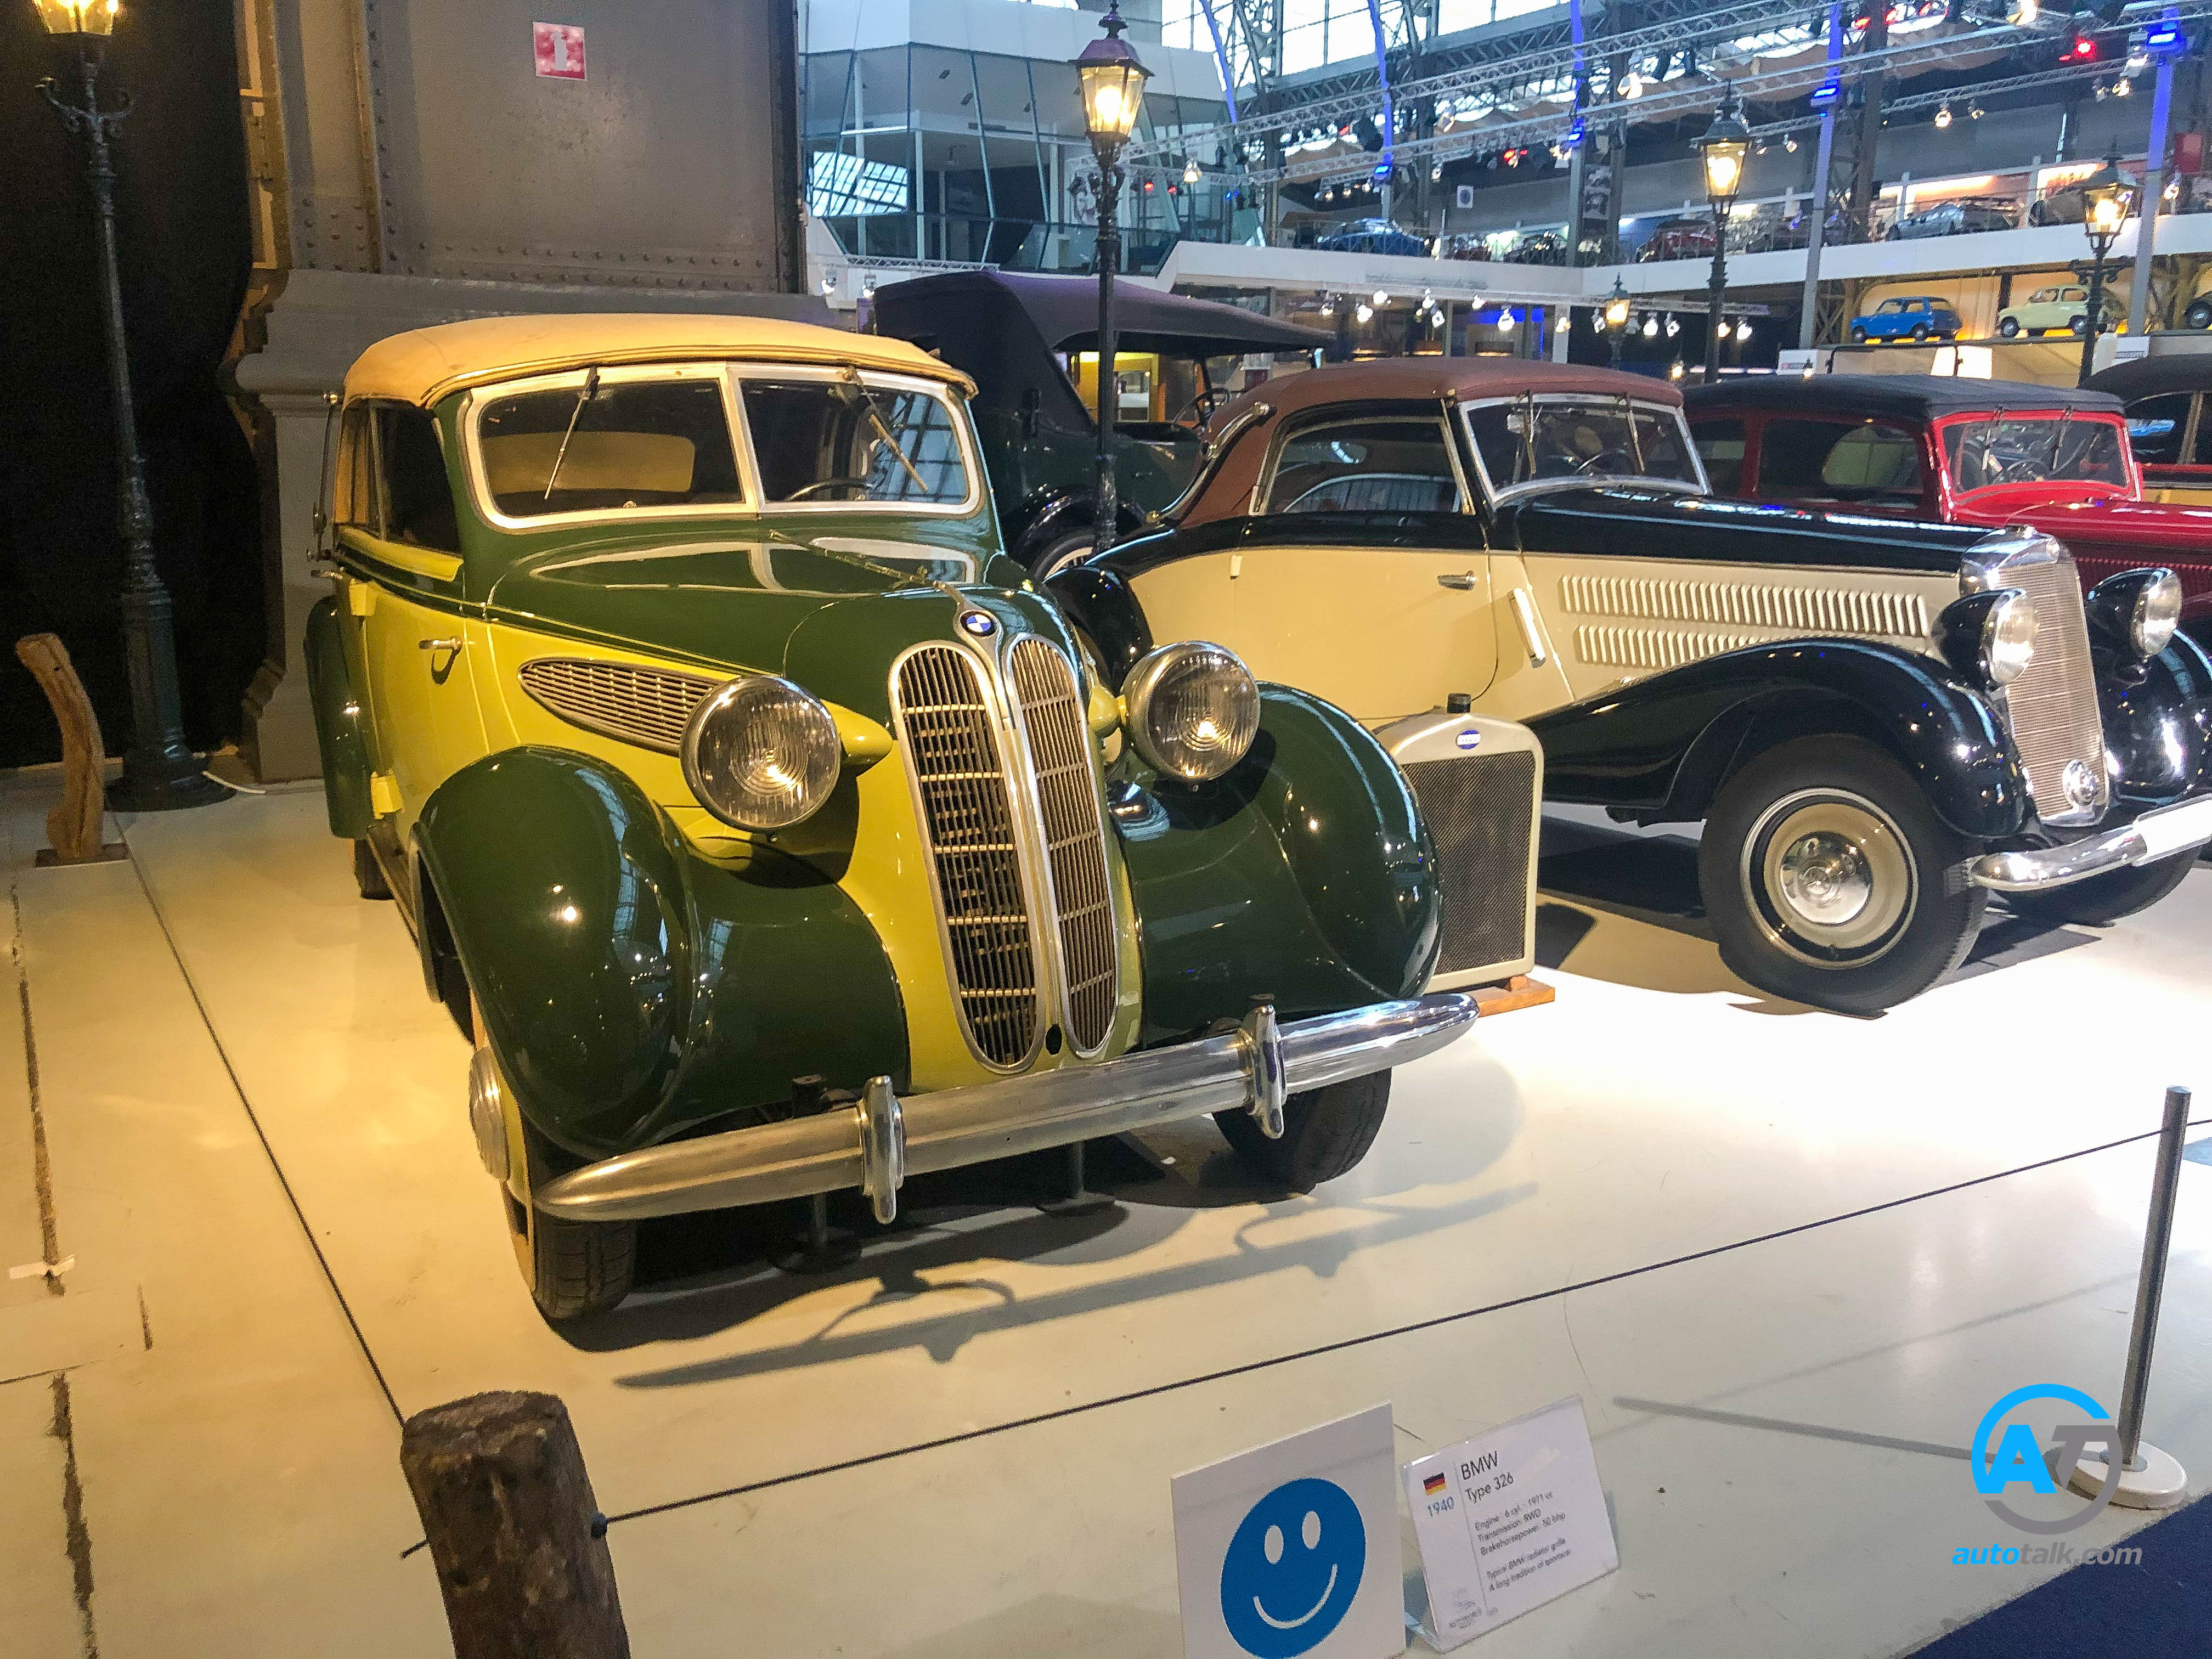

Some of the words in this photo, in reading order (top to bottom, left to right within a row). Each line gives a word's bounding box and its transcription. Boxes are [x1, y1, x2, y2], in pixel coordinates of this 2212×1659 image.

[1460, 1451, 1498, 1480] BMW
[1465, 1483, 1492, 1504] Type
[1493, 1471, 1514, 1491] 326
[1427, 1496, 1454, 1517] 1940
